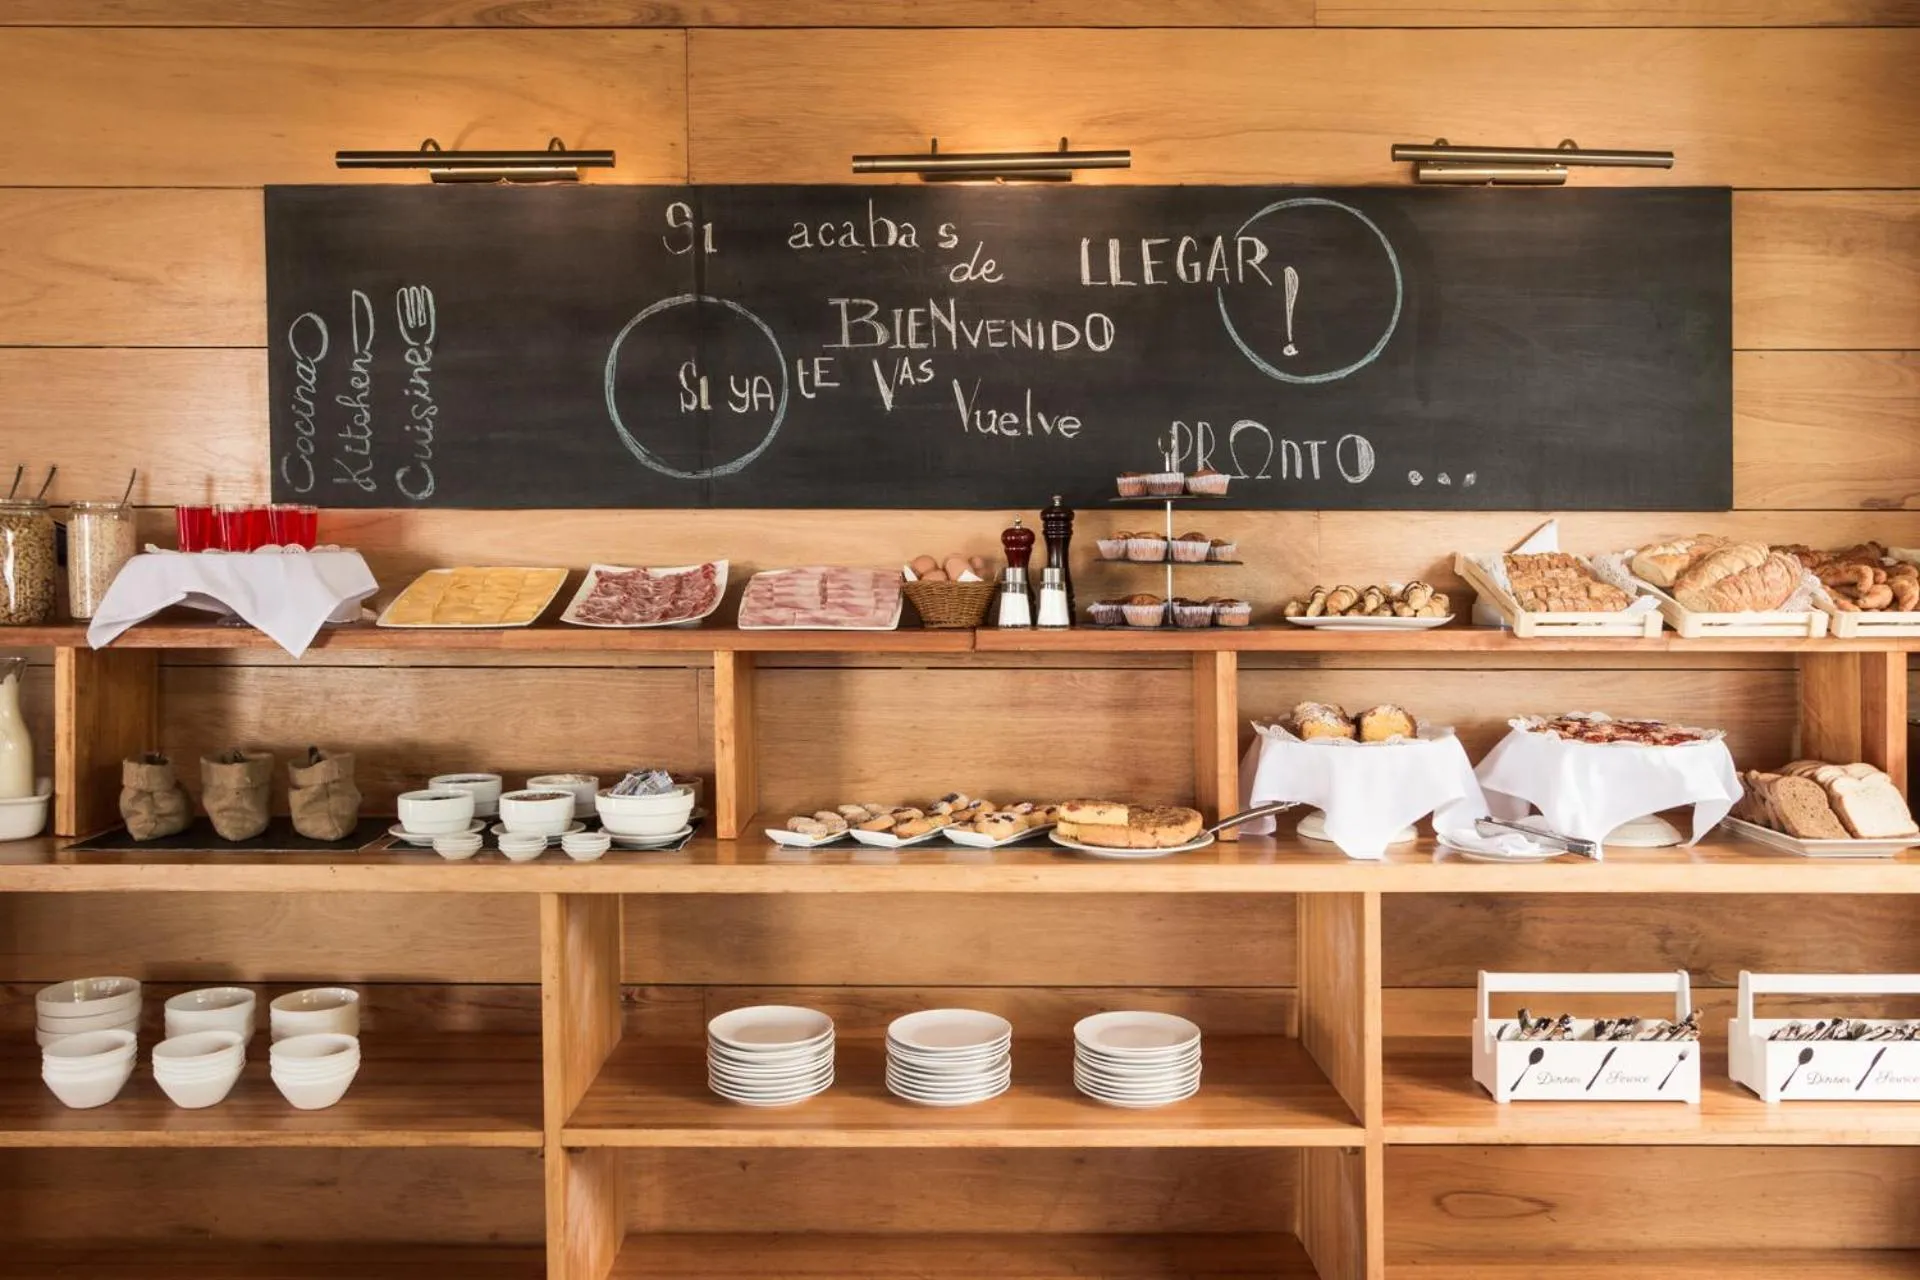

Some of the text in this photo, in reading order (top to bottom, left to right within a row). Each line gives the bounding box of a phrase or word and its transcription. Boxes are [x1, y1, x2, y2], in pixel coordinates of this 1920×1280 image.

[788, 198, 958, 248] acabas
[949, 241, 1003, 283] de
[1080, 236, 1272, 286] LLEGAR
[822, 298, 1115, 351] BIENVENIDO
[281, 350, 317, 493] Cocina
[333, 350, 377, 492] Kitchen
[396, 345, 438, 500] Cuisine
[872, 357, 934, 412] VAS
[952, 378, 1081, 438] Vuelve
